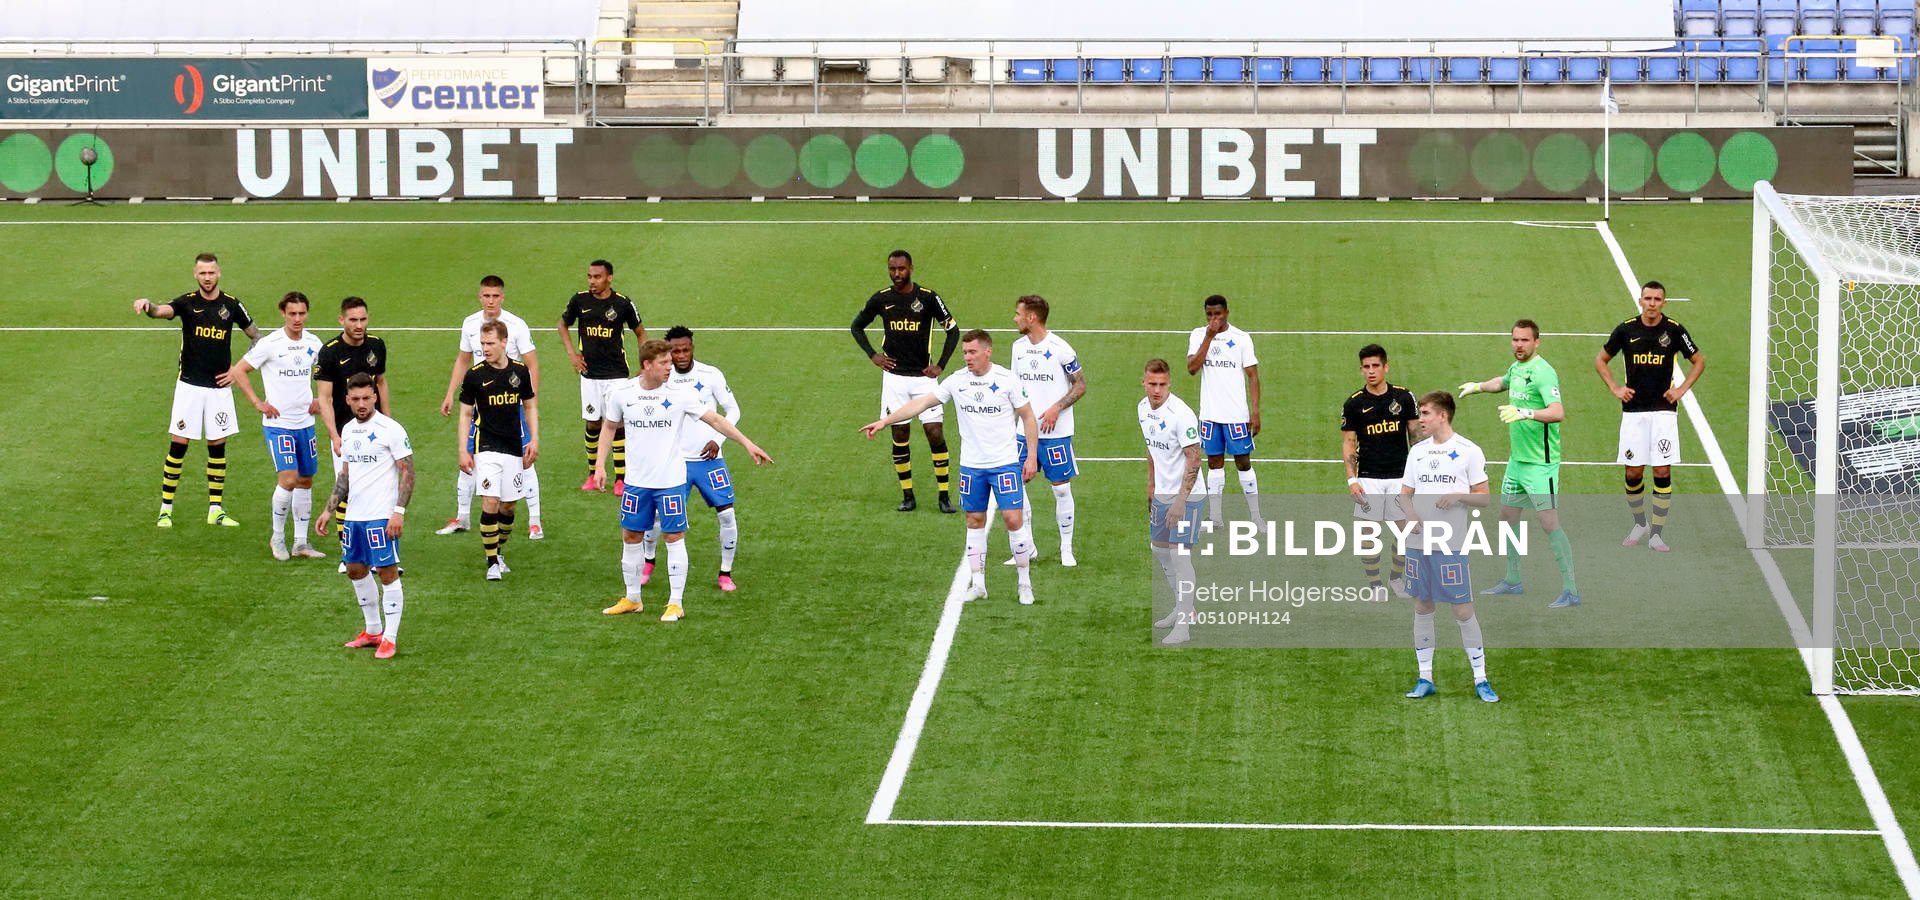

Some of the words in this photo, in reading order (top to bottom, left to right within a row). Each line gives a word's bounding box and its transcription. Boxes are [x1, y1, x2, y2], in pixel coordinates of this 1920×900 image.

[411, 69, 508, 80] PERFORMANCE
[29, 97, 59, 106] Complete
[60, 97, 90, 106] Company
[235, 97, 265, 106] Complete
[265, 97, 296, 106] Company
[411, 81, 539, 110] center
[236, 128, 574, 198] UNIBET
[1037, 128, 1378, 198] UNIBET
[586, 324, 614, 338] notar
[890, 318, 921, 332] notar
[194, 324, 228, 341] notar
[1204, 359, 1237, 369] OLMEN
[1633, 351, 1665, 365] notar
[278, 368, 311, 377] HOLME
[1065, 364, 1073, 373] C
[488, 391, 520, 406] notar
[959, 404, 1001, 414] HOLMEN
[1366, 419, 1400, 435] notar
[283, 455, 294, 465] 10
